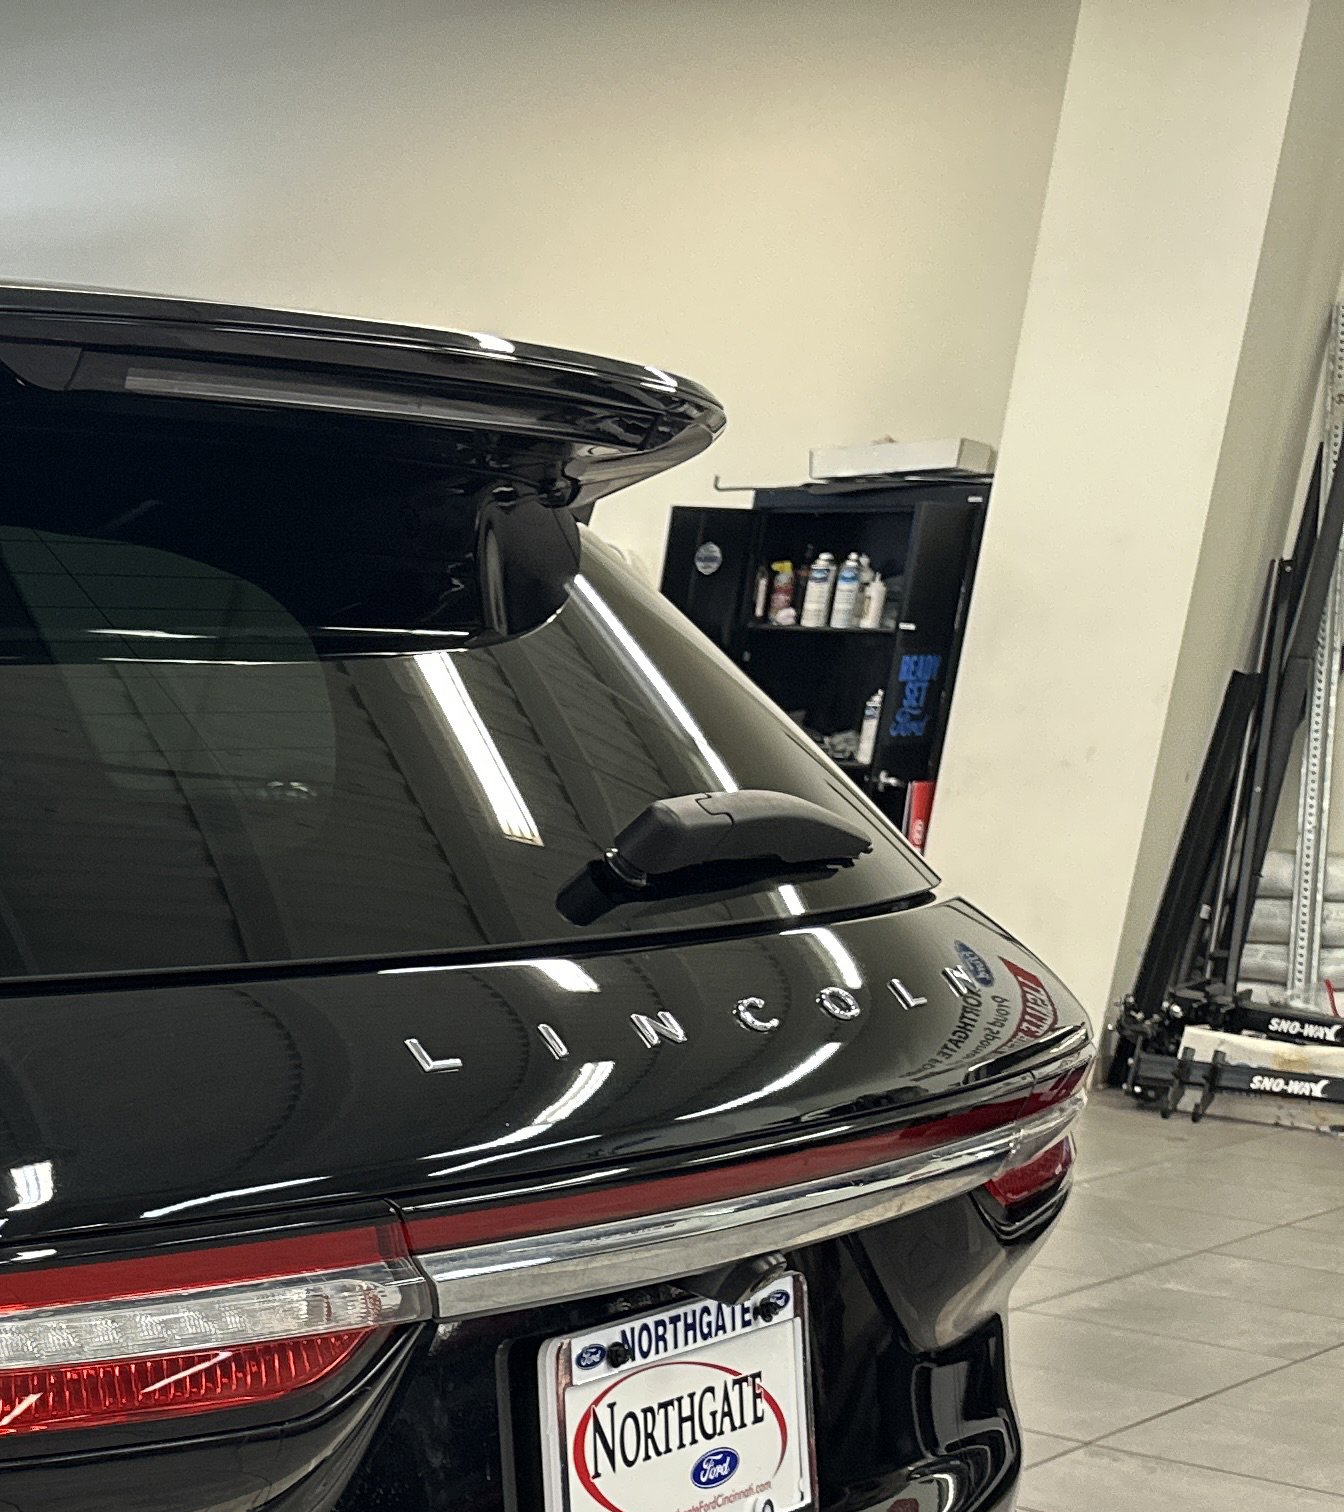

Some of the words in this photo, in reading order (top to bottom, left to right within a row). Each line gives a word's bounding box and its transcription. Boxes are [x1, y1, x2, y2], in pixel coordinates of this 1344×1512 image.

[403, 964, 977, 1073] LINCOLN
[1268, 1017, 1343, 1042] SNO-WAY
[1250, 1076, 1330, 1098] SNO-WAY
[620, 1302, 753, 1362] NORTHGATE
[698, 1450, 733, 1485] Ford
